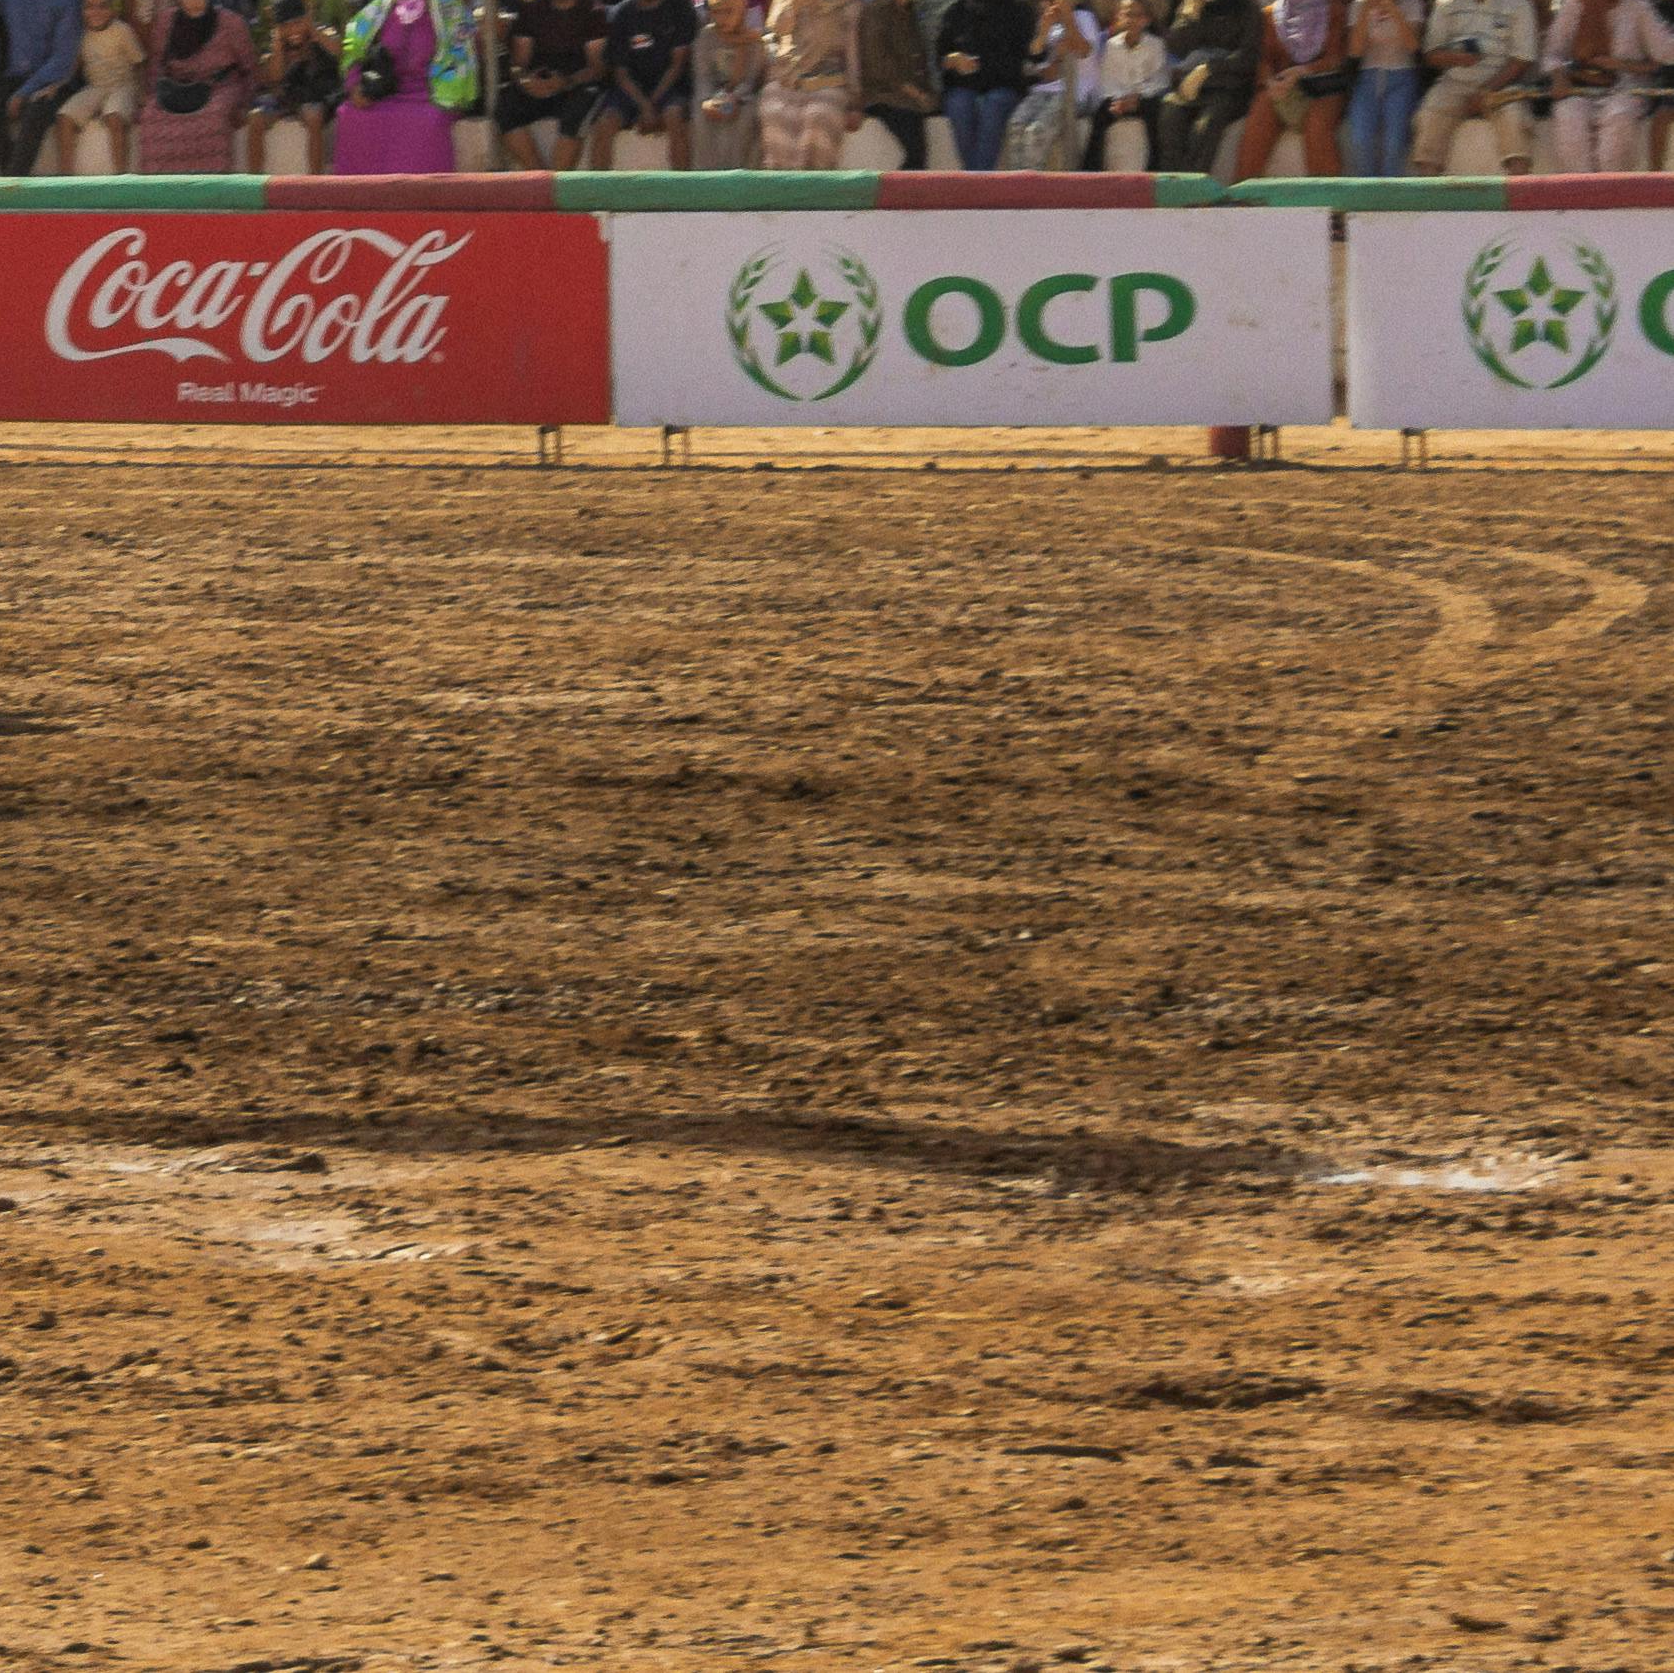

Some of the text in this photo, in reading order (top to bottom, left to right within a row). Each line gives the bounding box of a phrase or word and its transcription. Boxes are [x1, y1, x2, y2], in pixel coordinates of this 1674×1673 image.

[45, 227, 474, 364] Coca-Cola
[903, 272, 1198, 367] OCP
[177, 381, 324, 407] Real Magic
